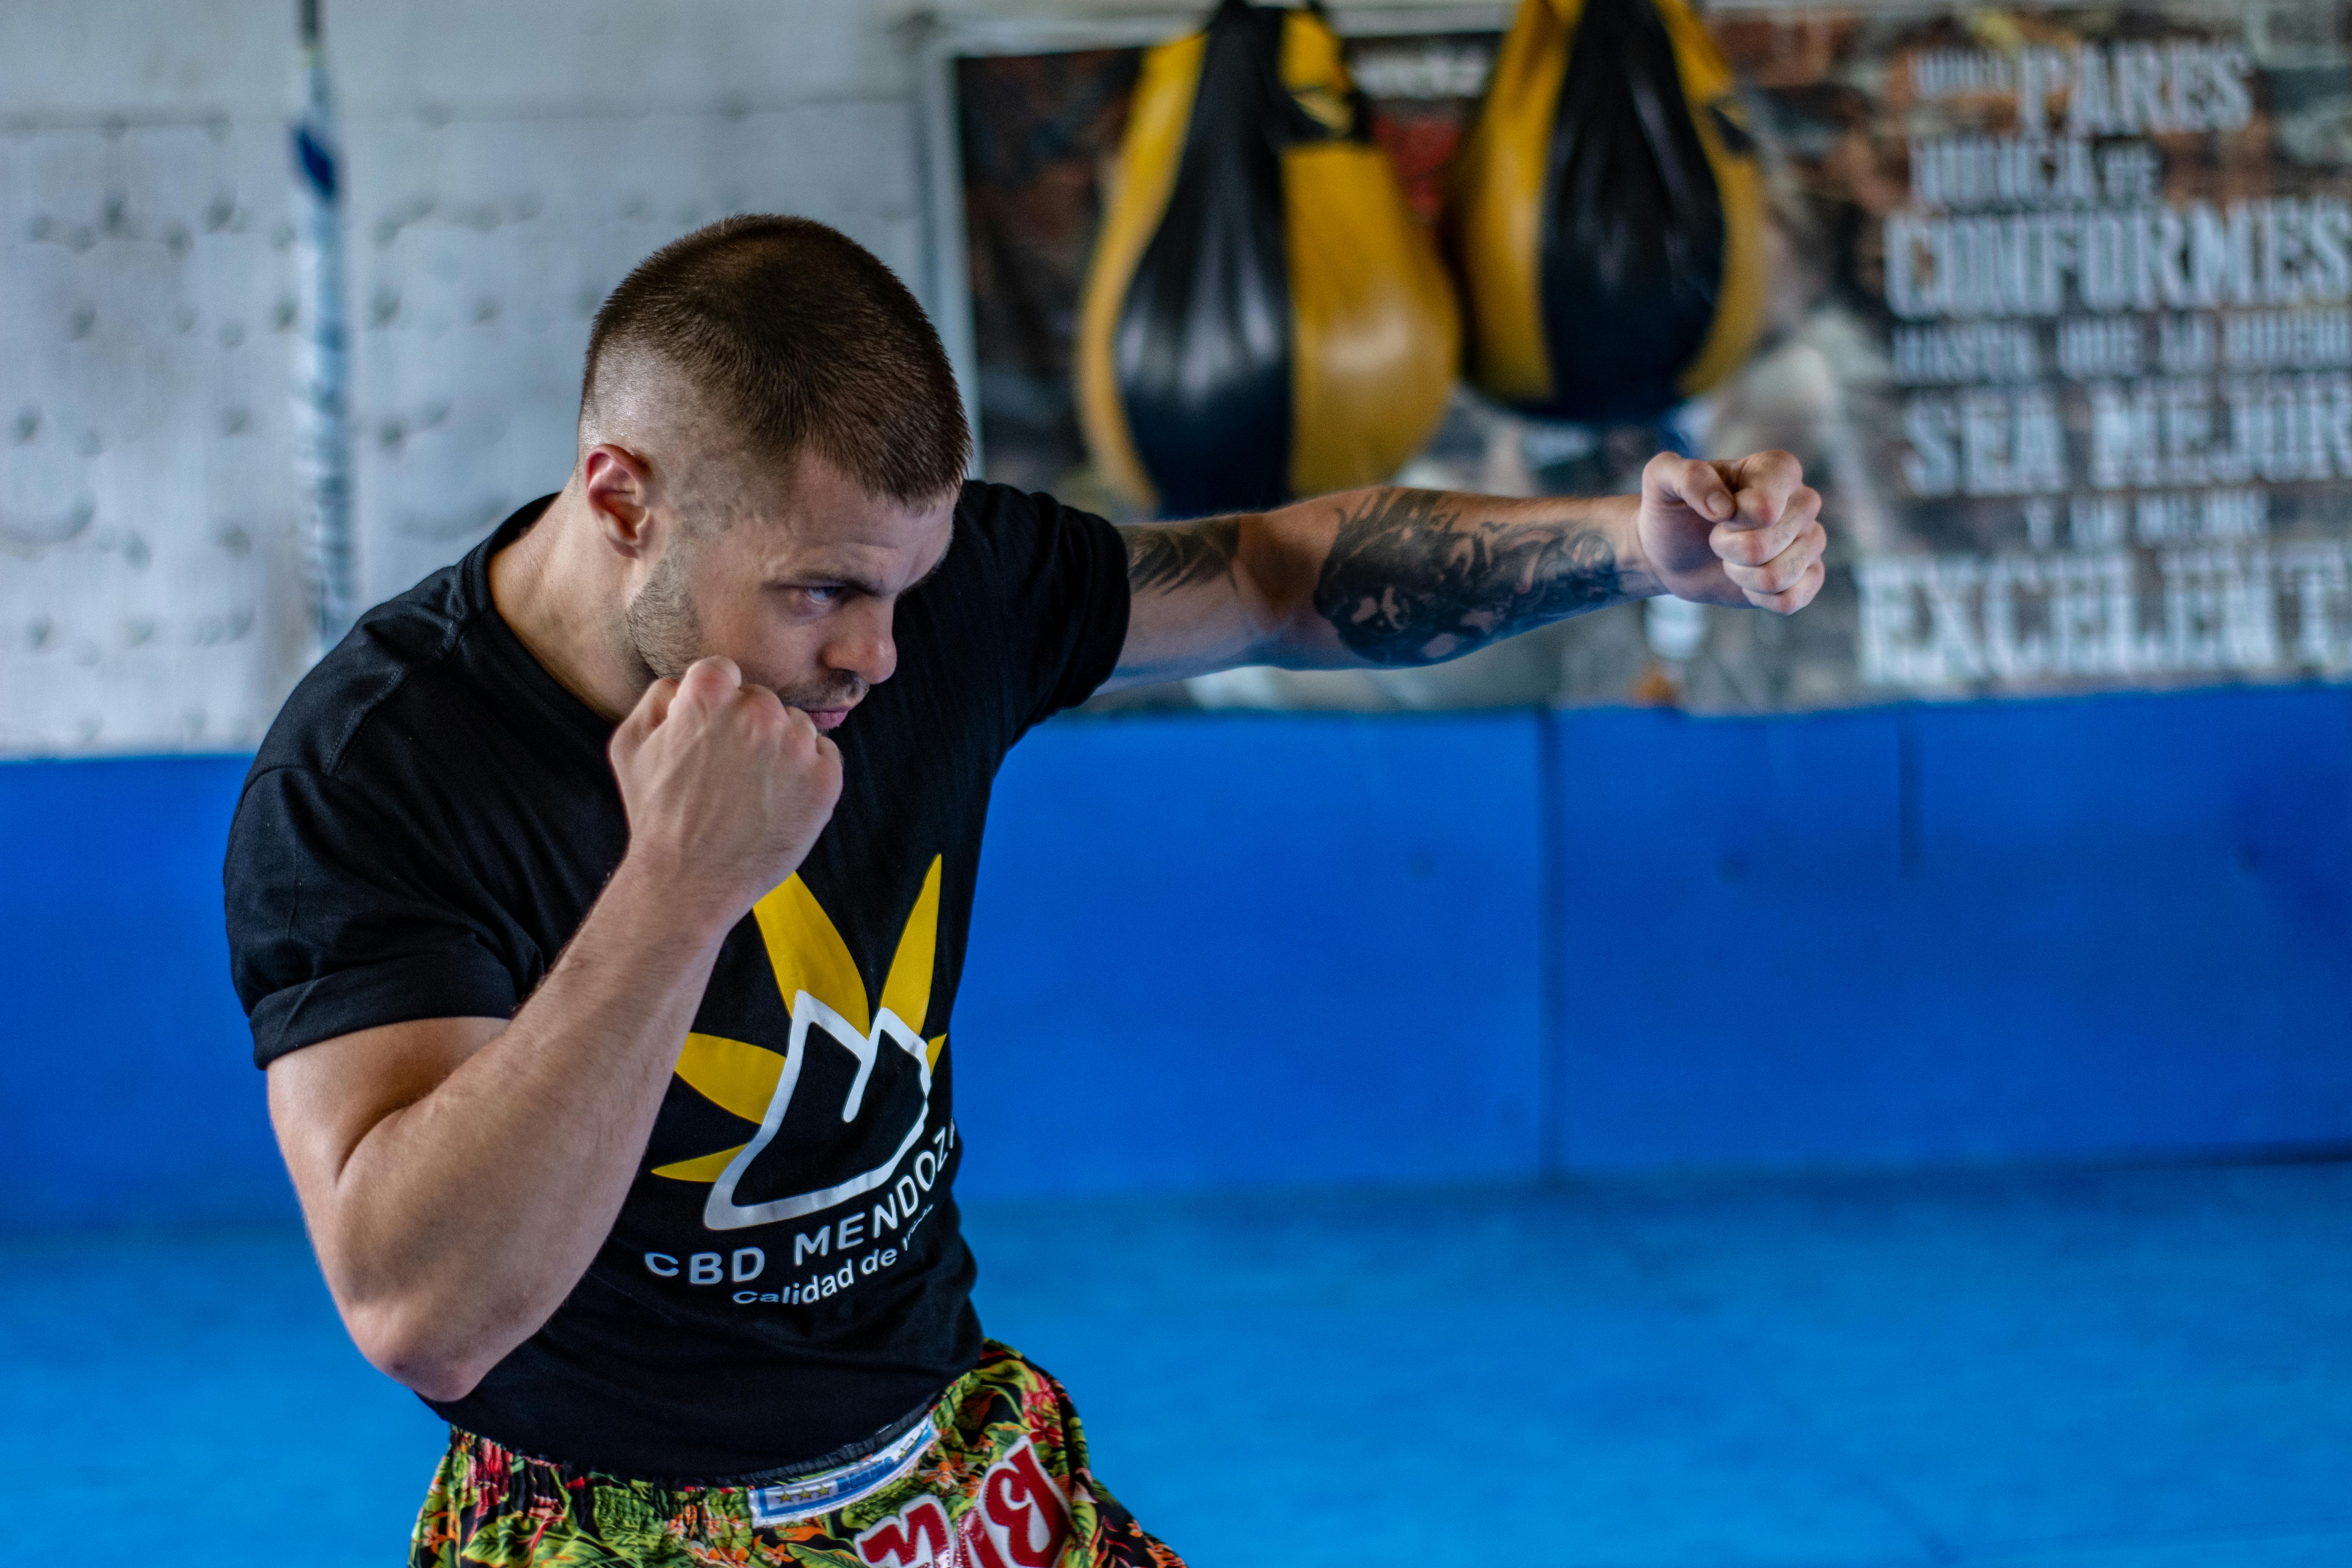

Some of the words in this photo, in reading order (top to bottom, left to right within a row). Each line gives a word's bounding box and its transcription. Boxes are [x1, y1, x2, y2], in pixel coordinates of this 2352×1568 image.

[2018, 36, 2255, 135] PARES
[1882, 196, 2352, 321] CONFORMES
[1901, 388, 2068, 498] SEA
[645, 1247, 765, 1284] CBD
[733, 1259, 853, 1304] Calidad
[862, 1248, 897, 1275] de
